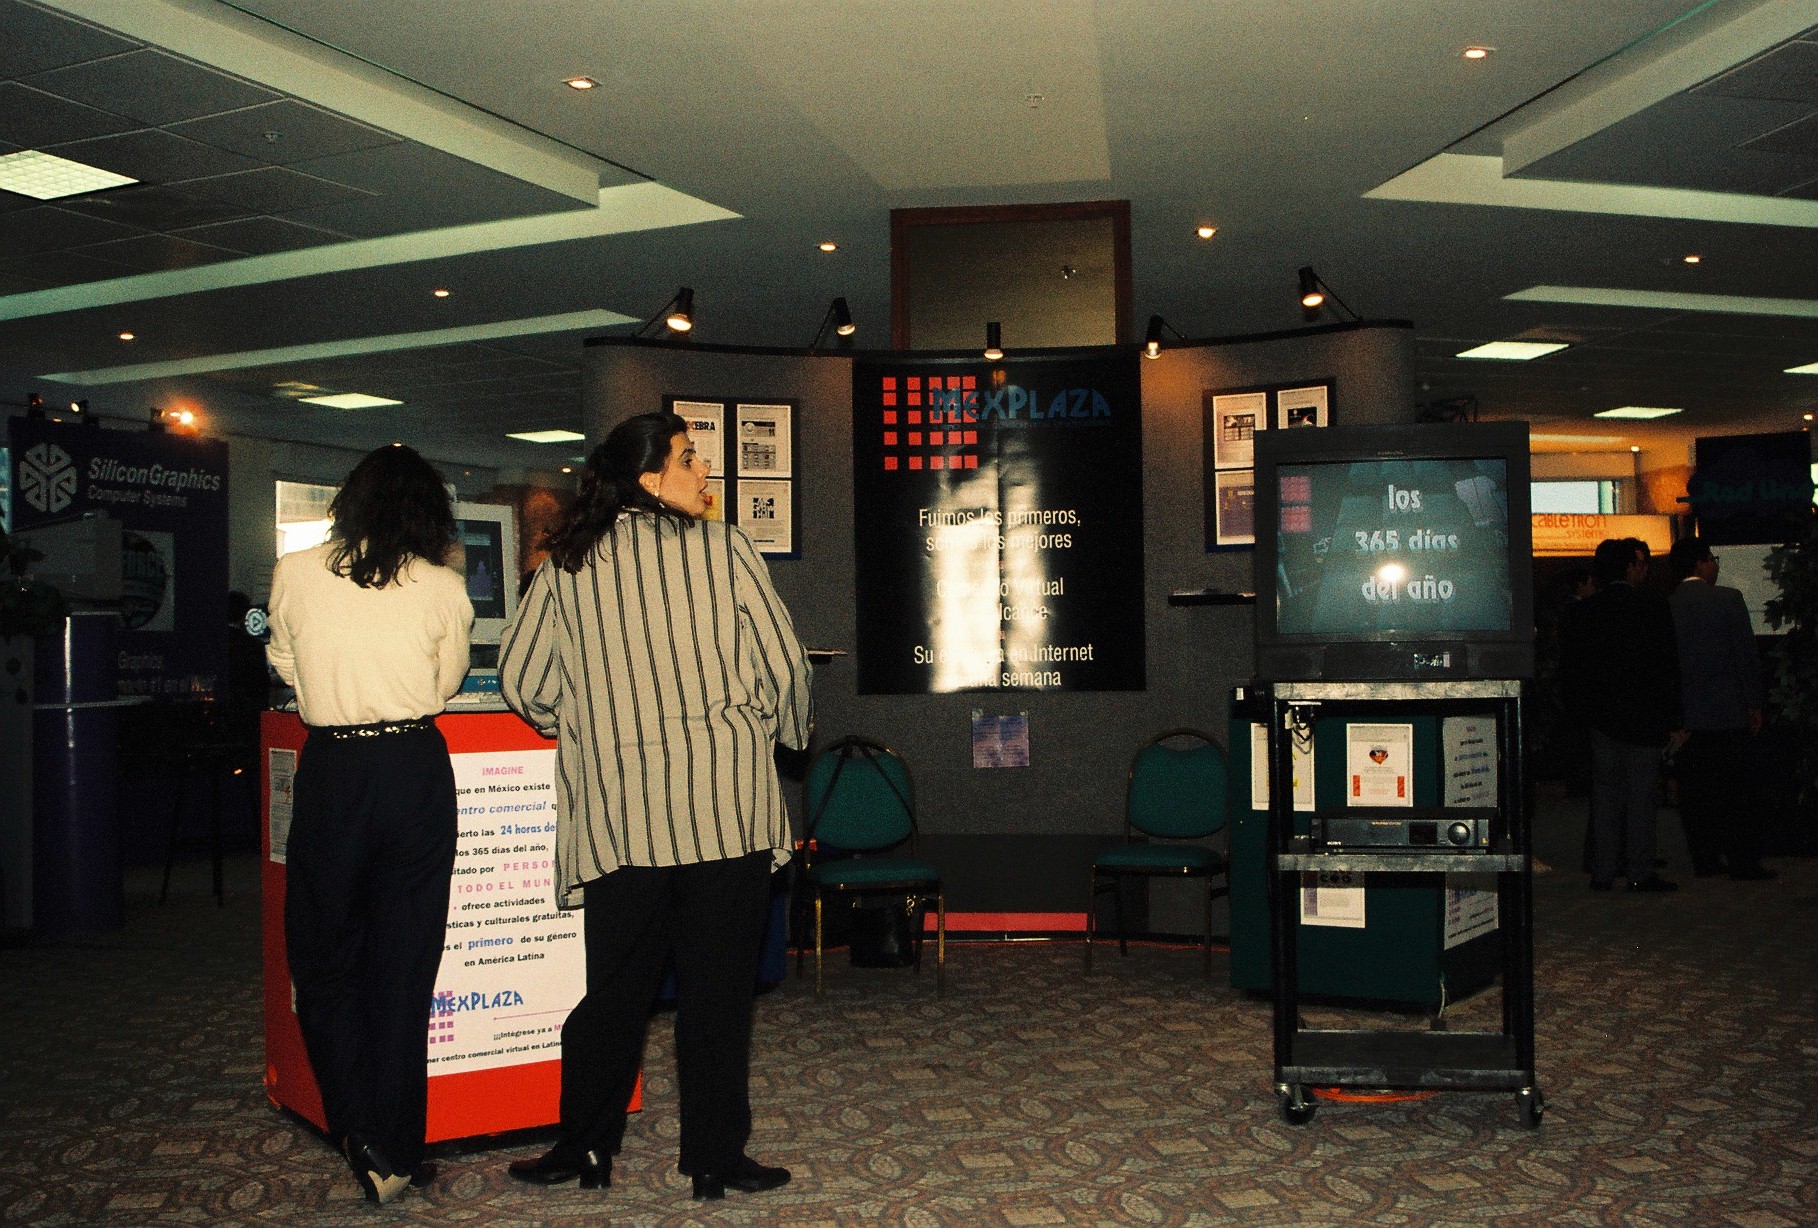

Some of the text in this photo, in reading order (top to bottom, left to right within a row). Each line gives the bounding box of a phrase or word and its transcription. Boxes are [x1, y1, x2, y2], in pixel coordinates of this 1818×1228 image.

[1387, 484, 1422, 511] los
[919, 508, 1082, 528] Fuimos los primeros,
[1355, 530, 1399, 552] 365
[1361, 574, 1455, 602] del año
[999, 602, 1049, 622] lcance
[914, 646, 934, 665] Su
[1034, 644, 1094, 663] Internet
[1002, 670, 1062, 687] semana
[482, 766, 524, 777] IMAGINE
[474, 787, 486, 795] en
[523, 782, 551, 792] existe
[456, 806, 486, 815] entro
[489, 801, 547, 814] comercial
[456, 821, 557, 839] ierto las 24 horas de
[472, 846, 490, 857] 365
[513, 844, 528, 853] del
[453, 860, 556, 876] itado por PERSO
[457, 878, 550, 894] TODO EL MUN
[461, 896, 546, 911] ofrece actividades
[445, 919, 475, 930] sticas
[476, 919, 484, 929] y
[485, 914, 531, 926] culturales
[453, 941, 463, 951] el
[467, 936, 514, 951] primero
[520, 935, 532, 944] de
[534, 934, 545, 943] su
[464, 958, 476, 968] en
[518, 951, 546, 963] Latina
[537, 1027, 547, 1036] ya
[441, 1052, 467, 1063] centro
[468, 1046, 505, 1059] comercial
[506, 1044, 530, 1055] virtual
[531, 1043, 541, 1052] en
